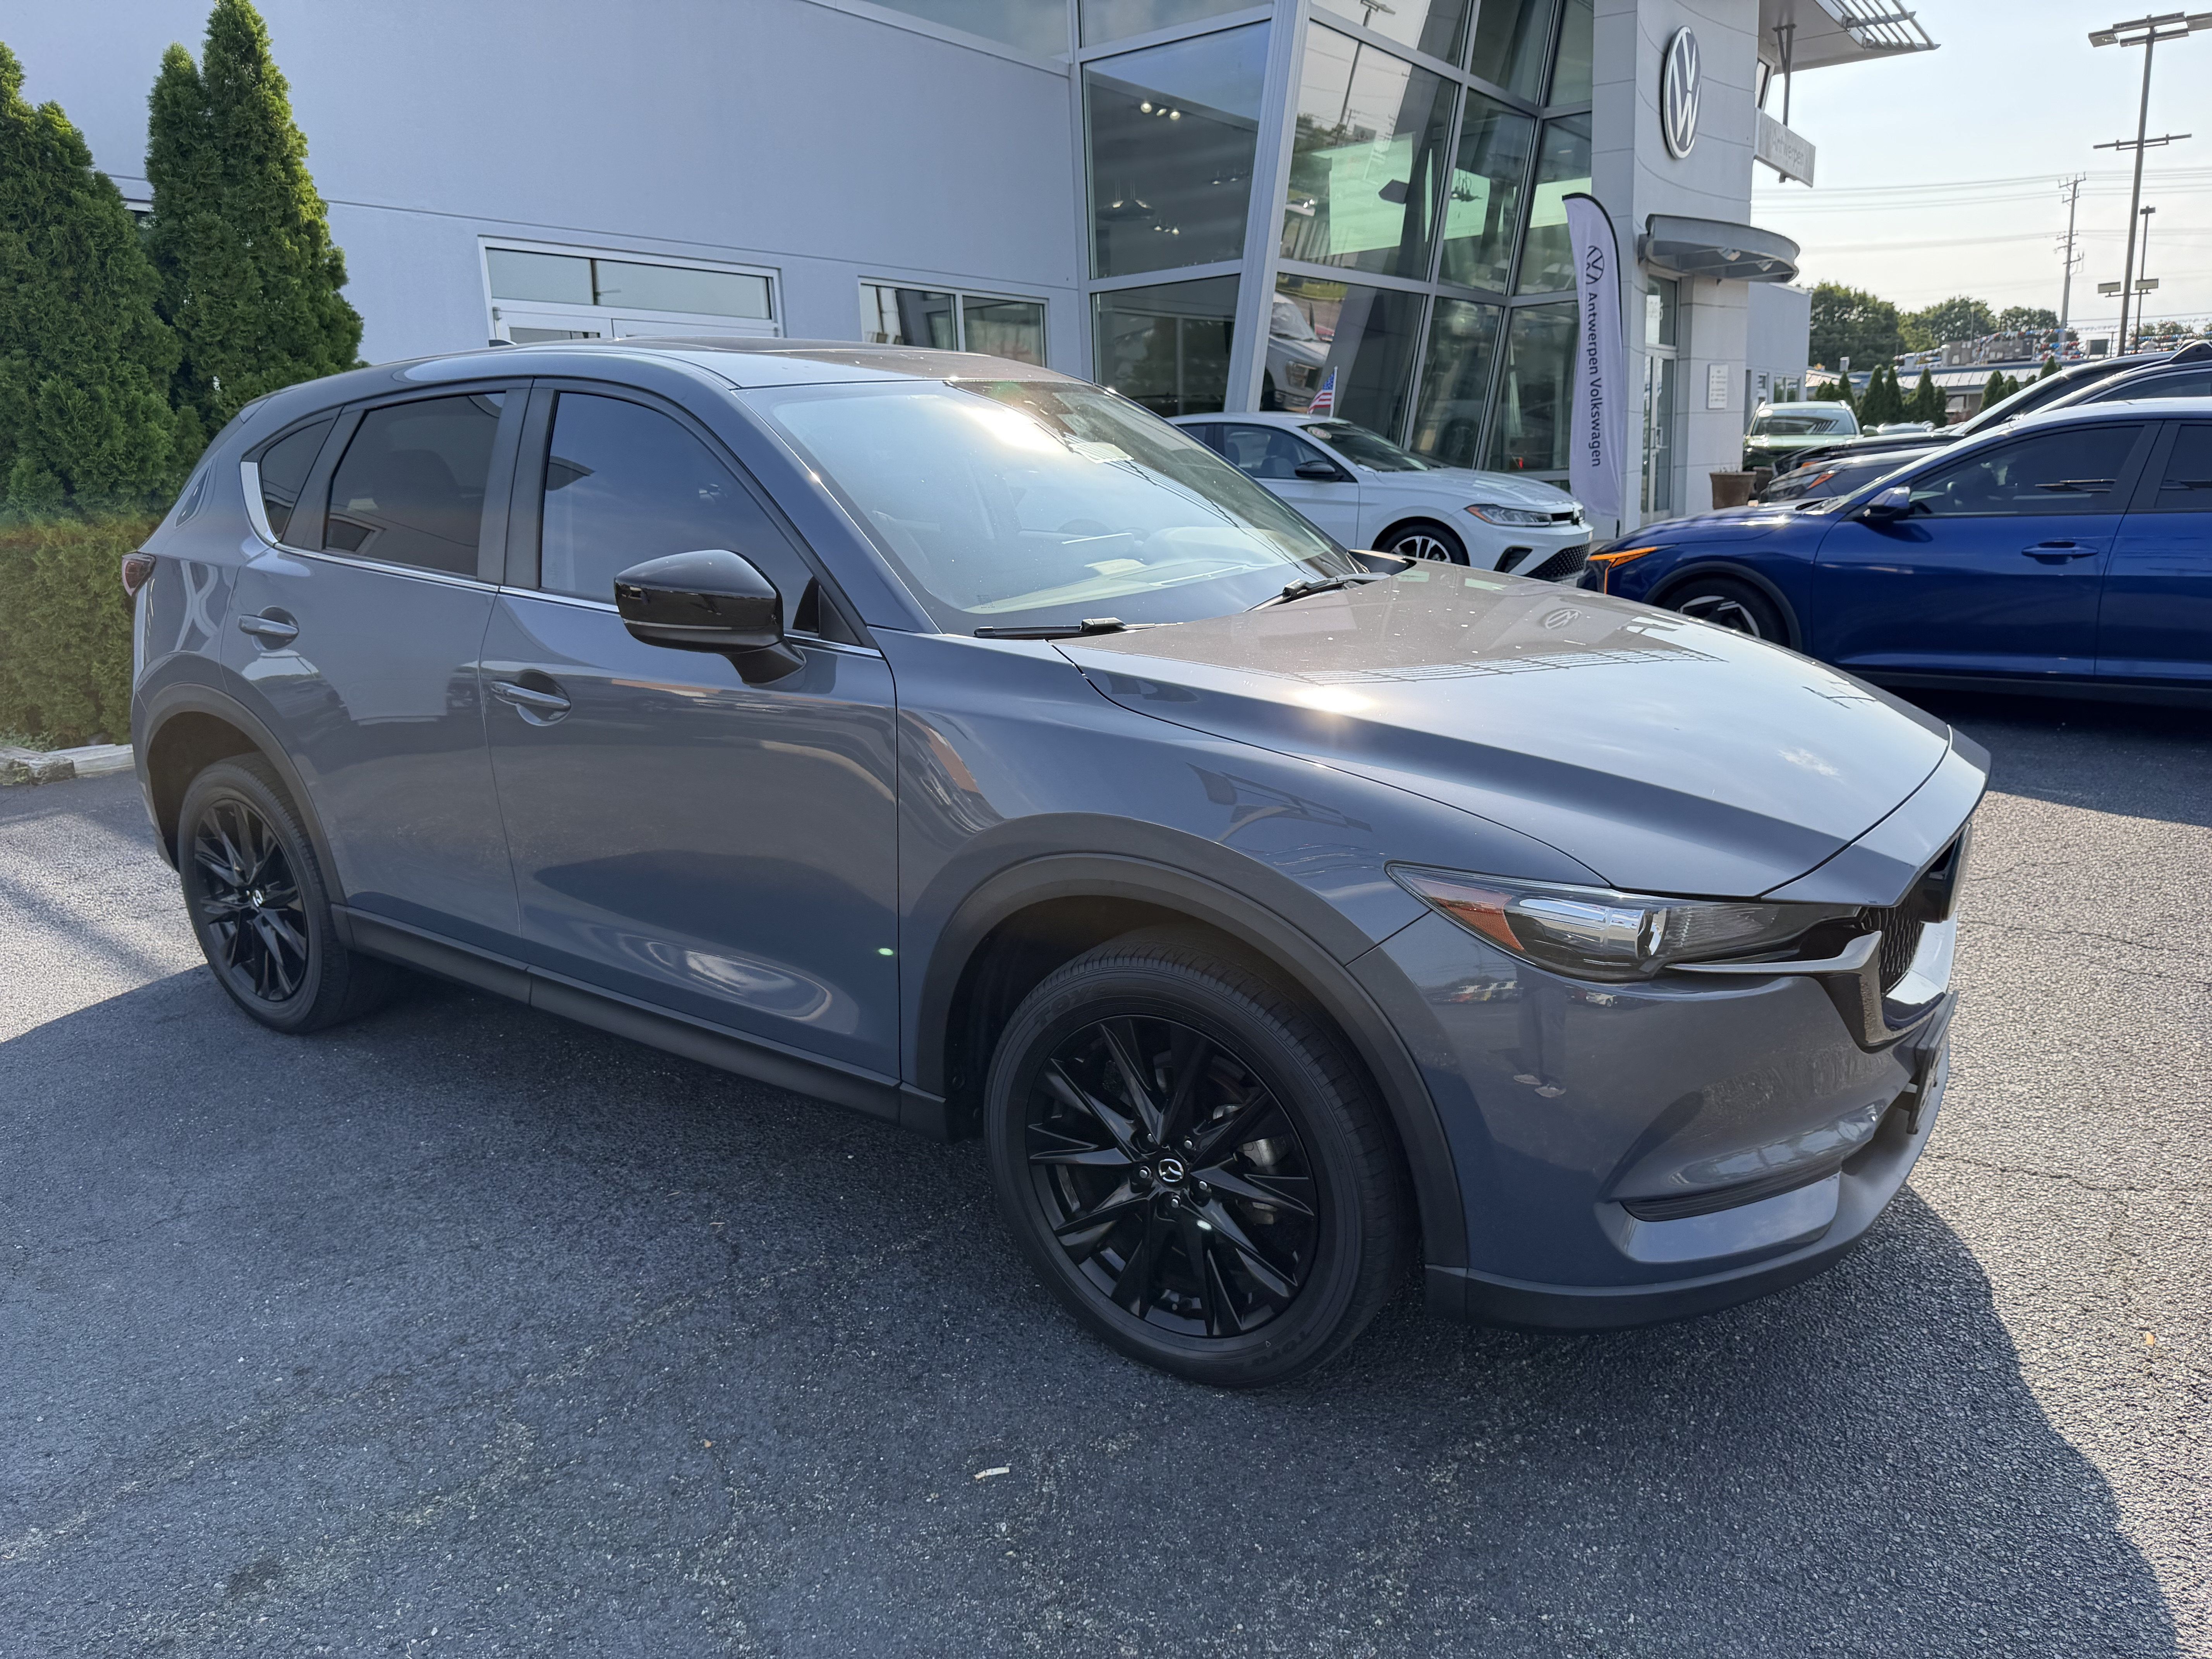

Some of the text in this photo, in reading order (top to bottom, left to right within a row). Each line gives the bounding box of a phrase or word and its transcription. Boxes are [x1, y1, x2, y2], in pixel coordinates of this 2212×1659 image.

[1587, 292, 1602, 467] Antwerpen Volkswagen
[1033, 982, 1113, 1028] TOYO
